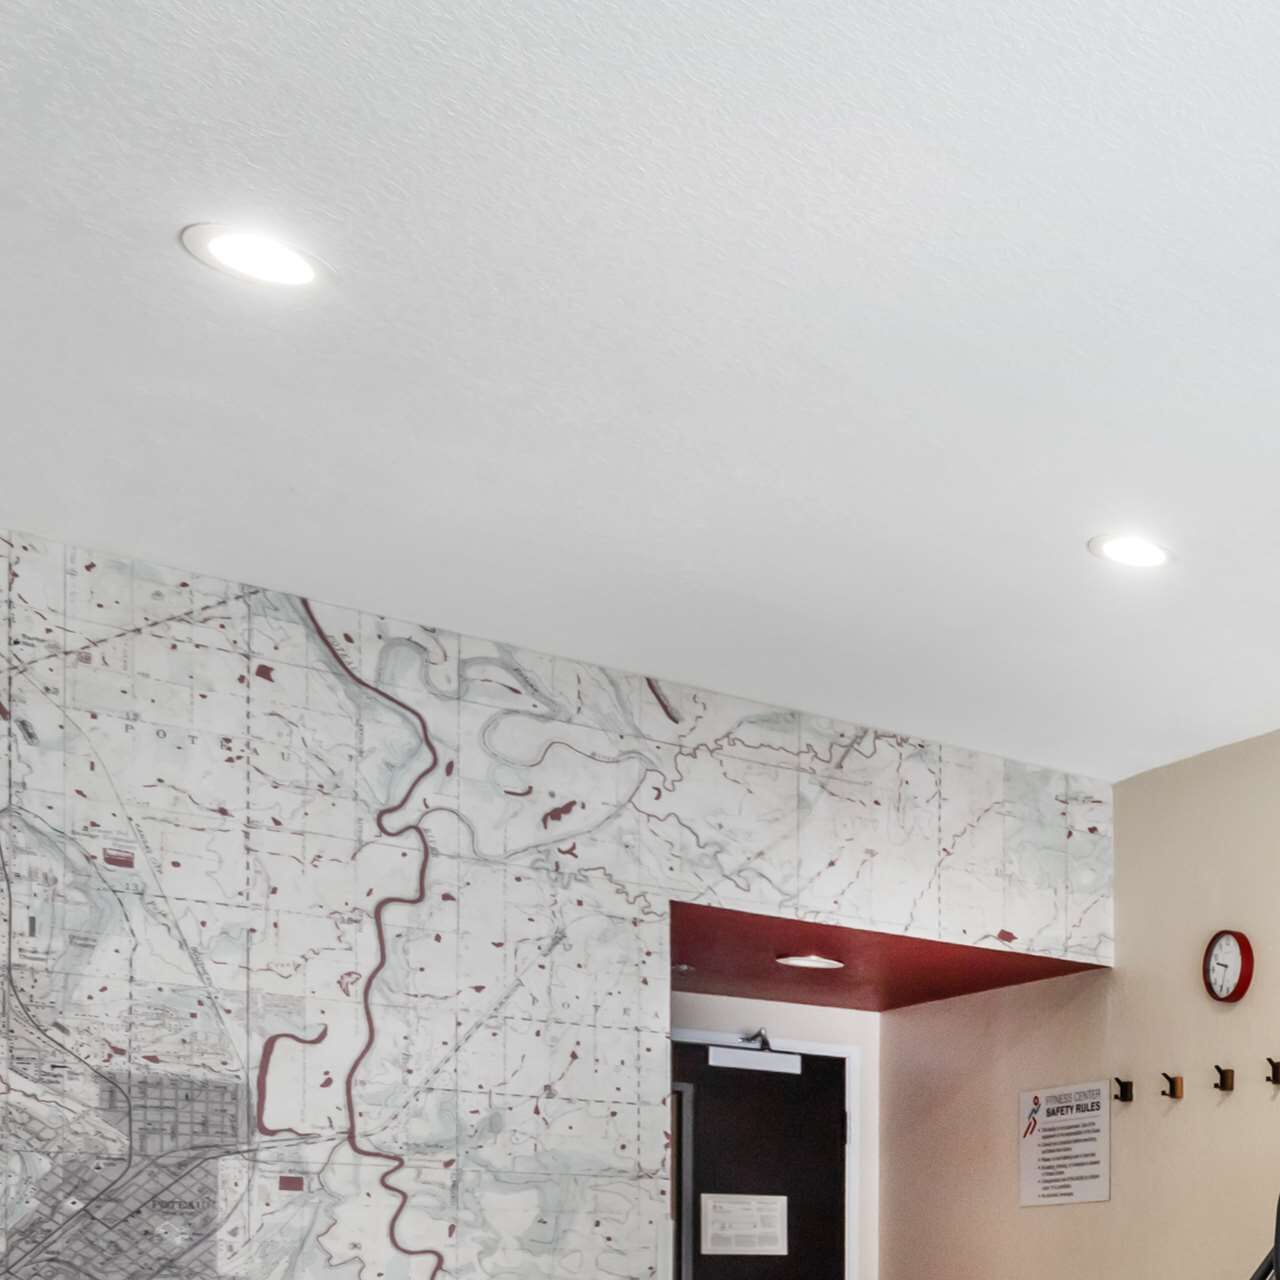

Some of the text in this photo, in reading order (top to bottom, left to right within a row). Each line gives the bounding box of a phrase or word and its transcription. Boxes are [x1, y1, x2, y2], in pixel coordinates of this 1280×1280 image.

[1046, 1088, 1101, 1106] FITNESS CENTER
[1046, 1101, 1101, 1118] SAFETY RULES
